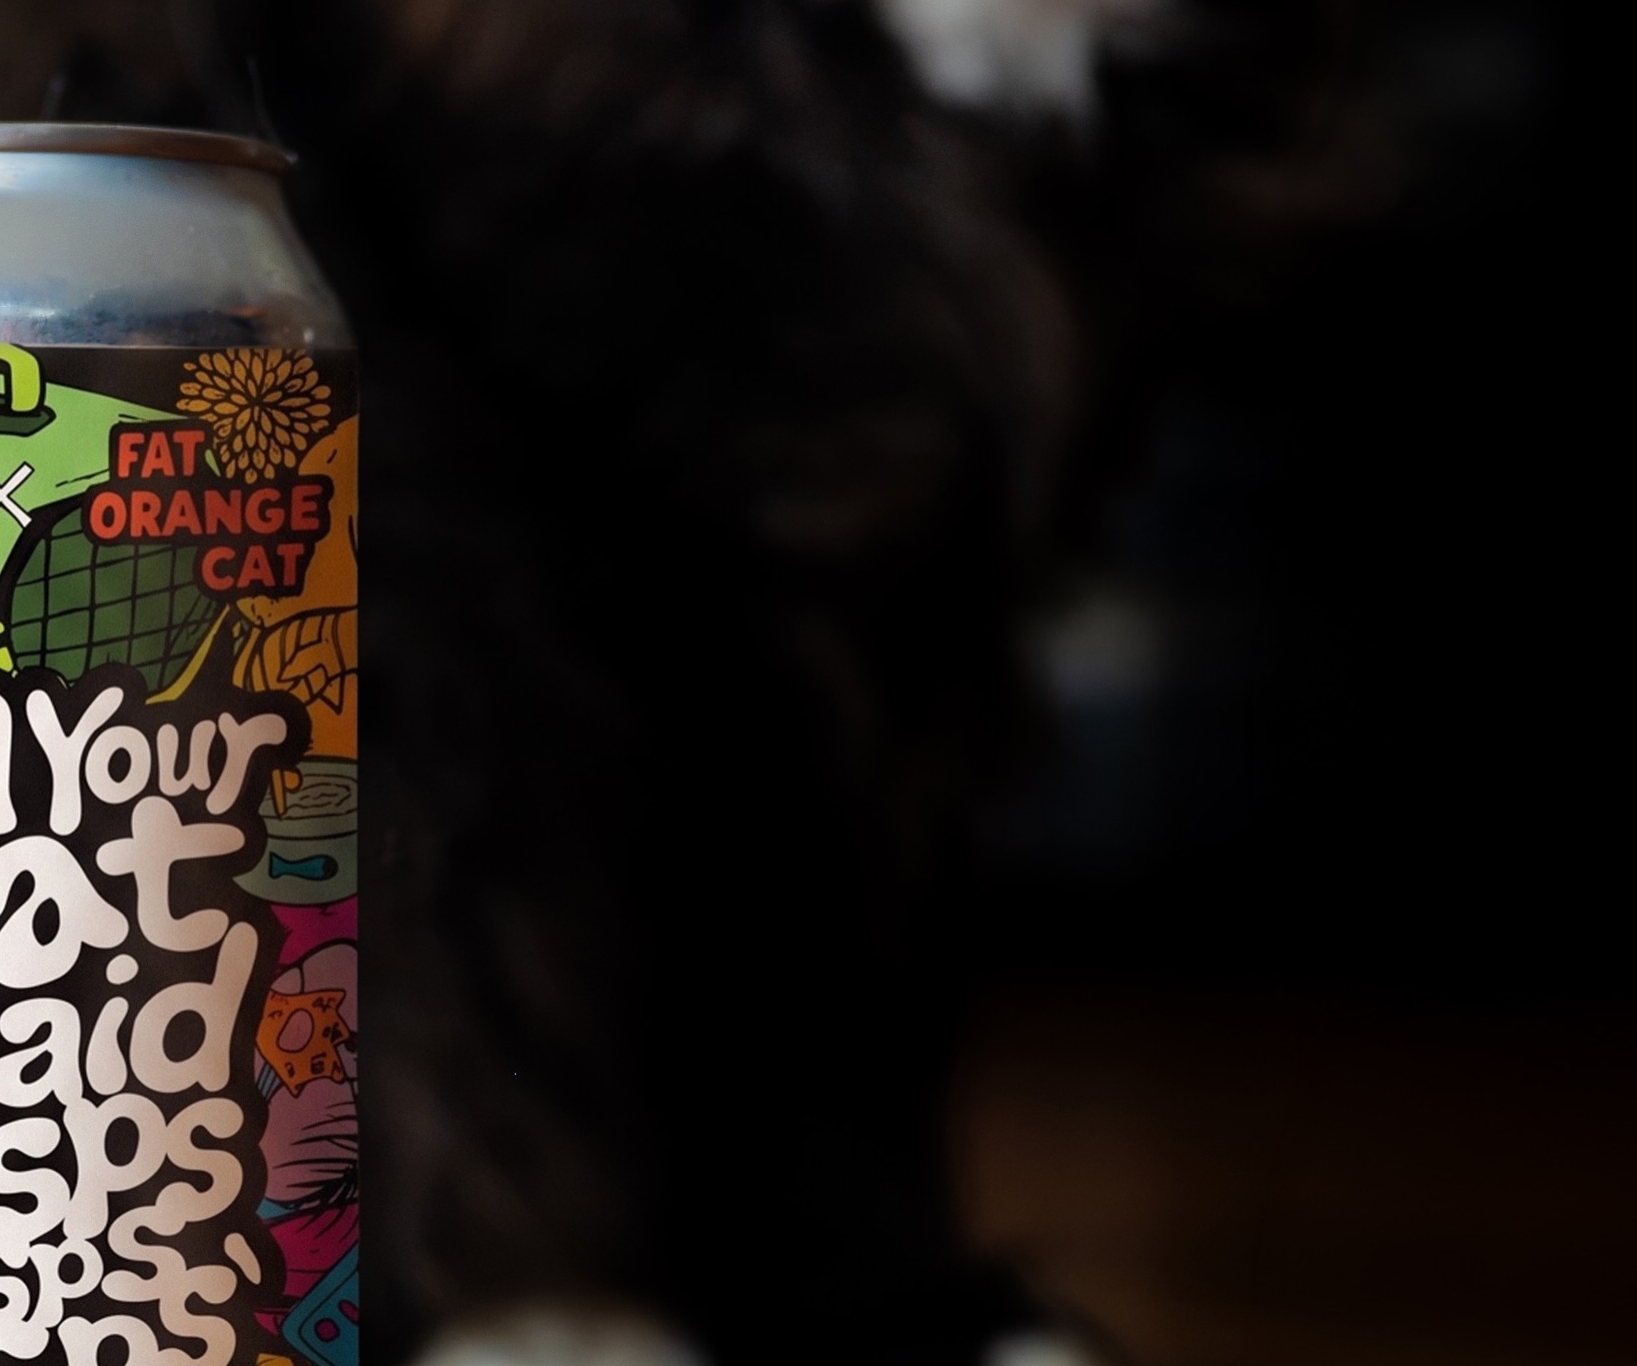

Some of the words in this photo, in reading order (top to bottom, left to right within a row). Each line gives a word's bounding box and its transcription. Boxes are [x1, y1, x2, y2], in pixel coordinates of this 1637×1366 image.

[117, 430, 206, 478] FAT
[89, 484, 323, 540] ORANGE
[201, 543, 305, 591] CAT
[25, 686, 288, 836] Your
